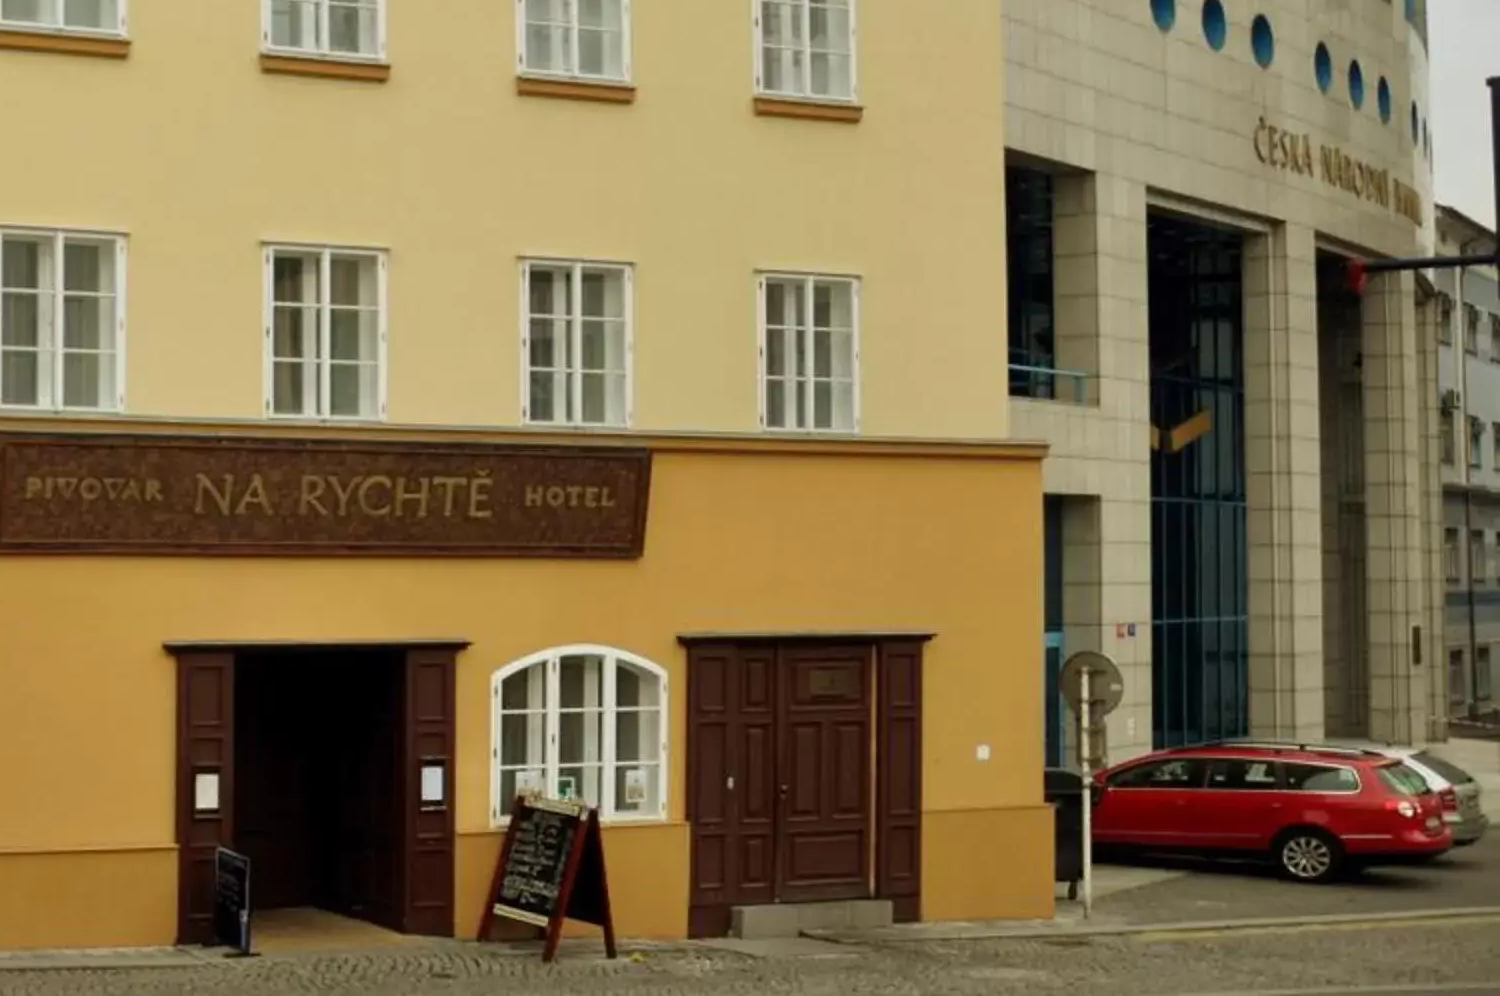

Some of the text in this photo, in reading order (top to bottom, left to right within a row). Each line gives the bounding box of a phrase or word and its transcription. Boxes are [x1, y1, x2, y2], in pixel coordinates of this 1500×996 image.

[24, 468, 616, 518] PIVOVAR NA RYCHTĚ HOTEL
